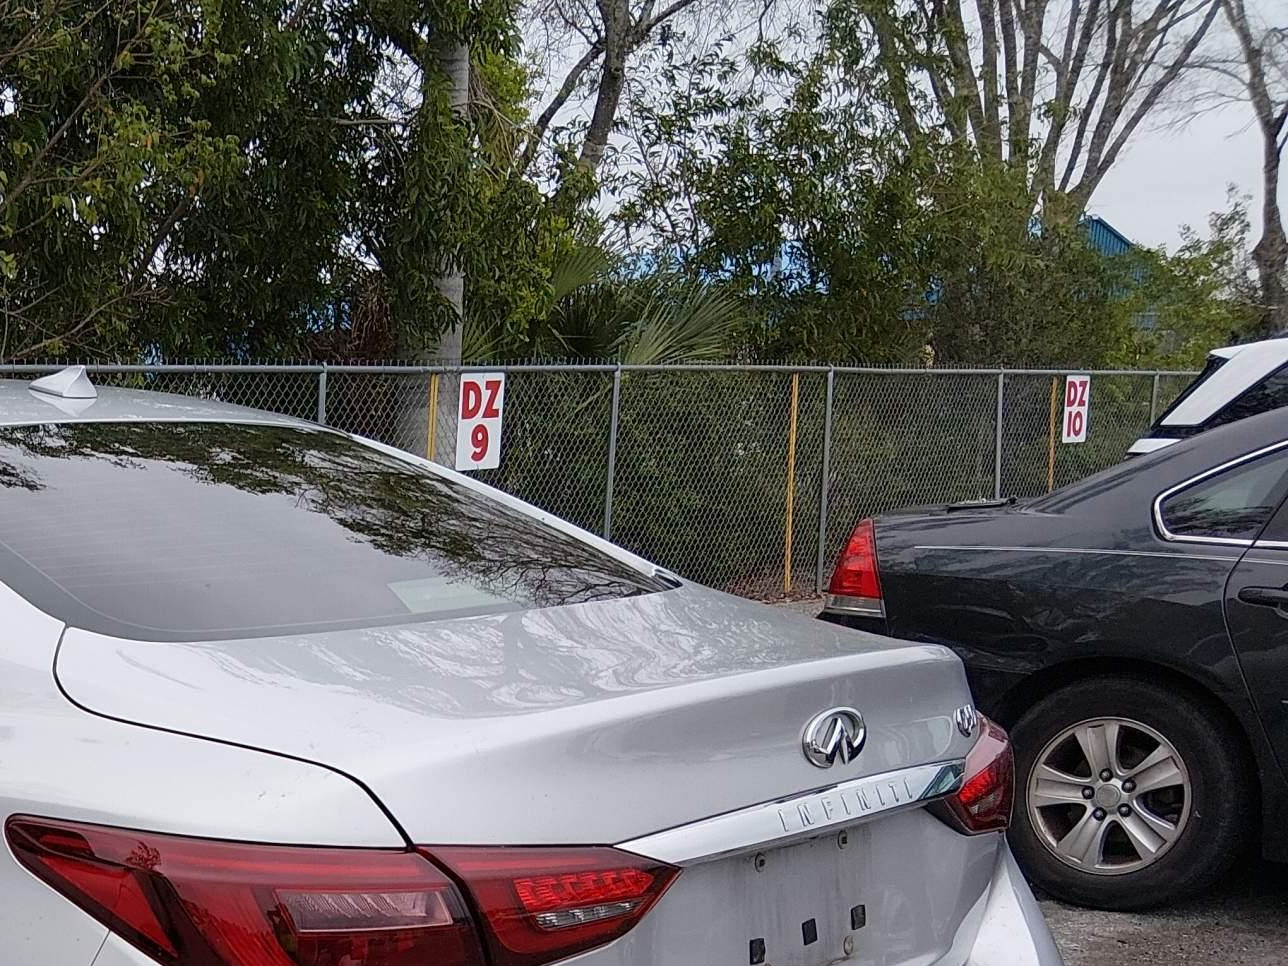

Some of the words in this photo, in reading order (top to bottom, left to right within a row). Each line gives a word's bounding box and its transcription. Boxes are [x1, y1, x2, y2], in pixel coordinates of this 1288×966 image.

[462, 381, 501, 419] DZ
[1066, 381, 1088, 407] DZ
[1066, 411, 1083, 437] 10
[471, 425, 489, 461] 9
[777, 776, 913, 832] INFINITI
